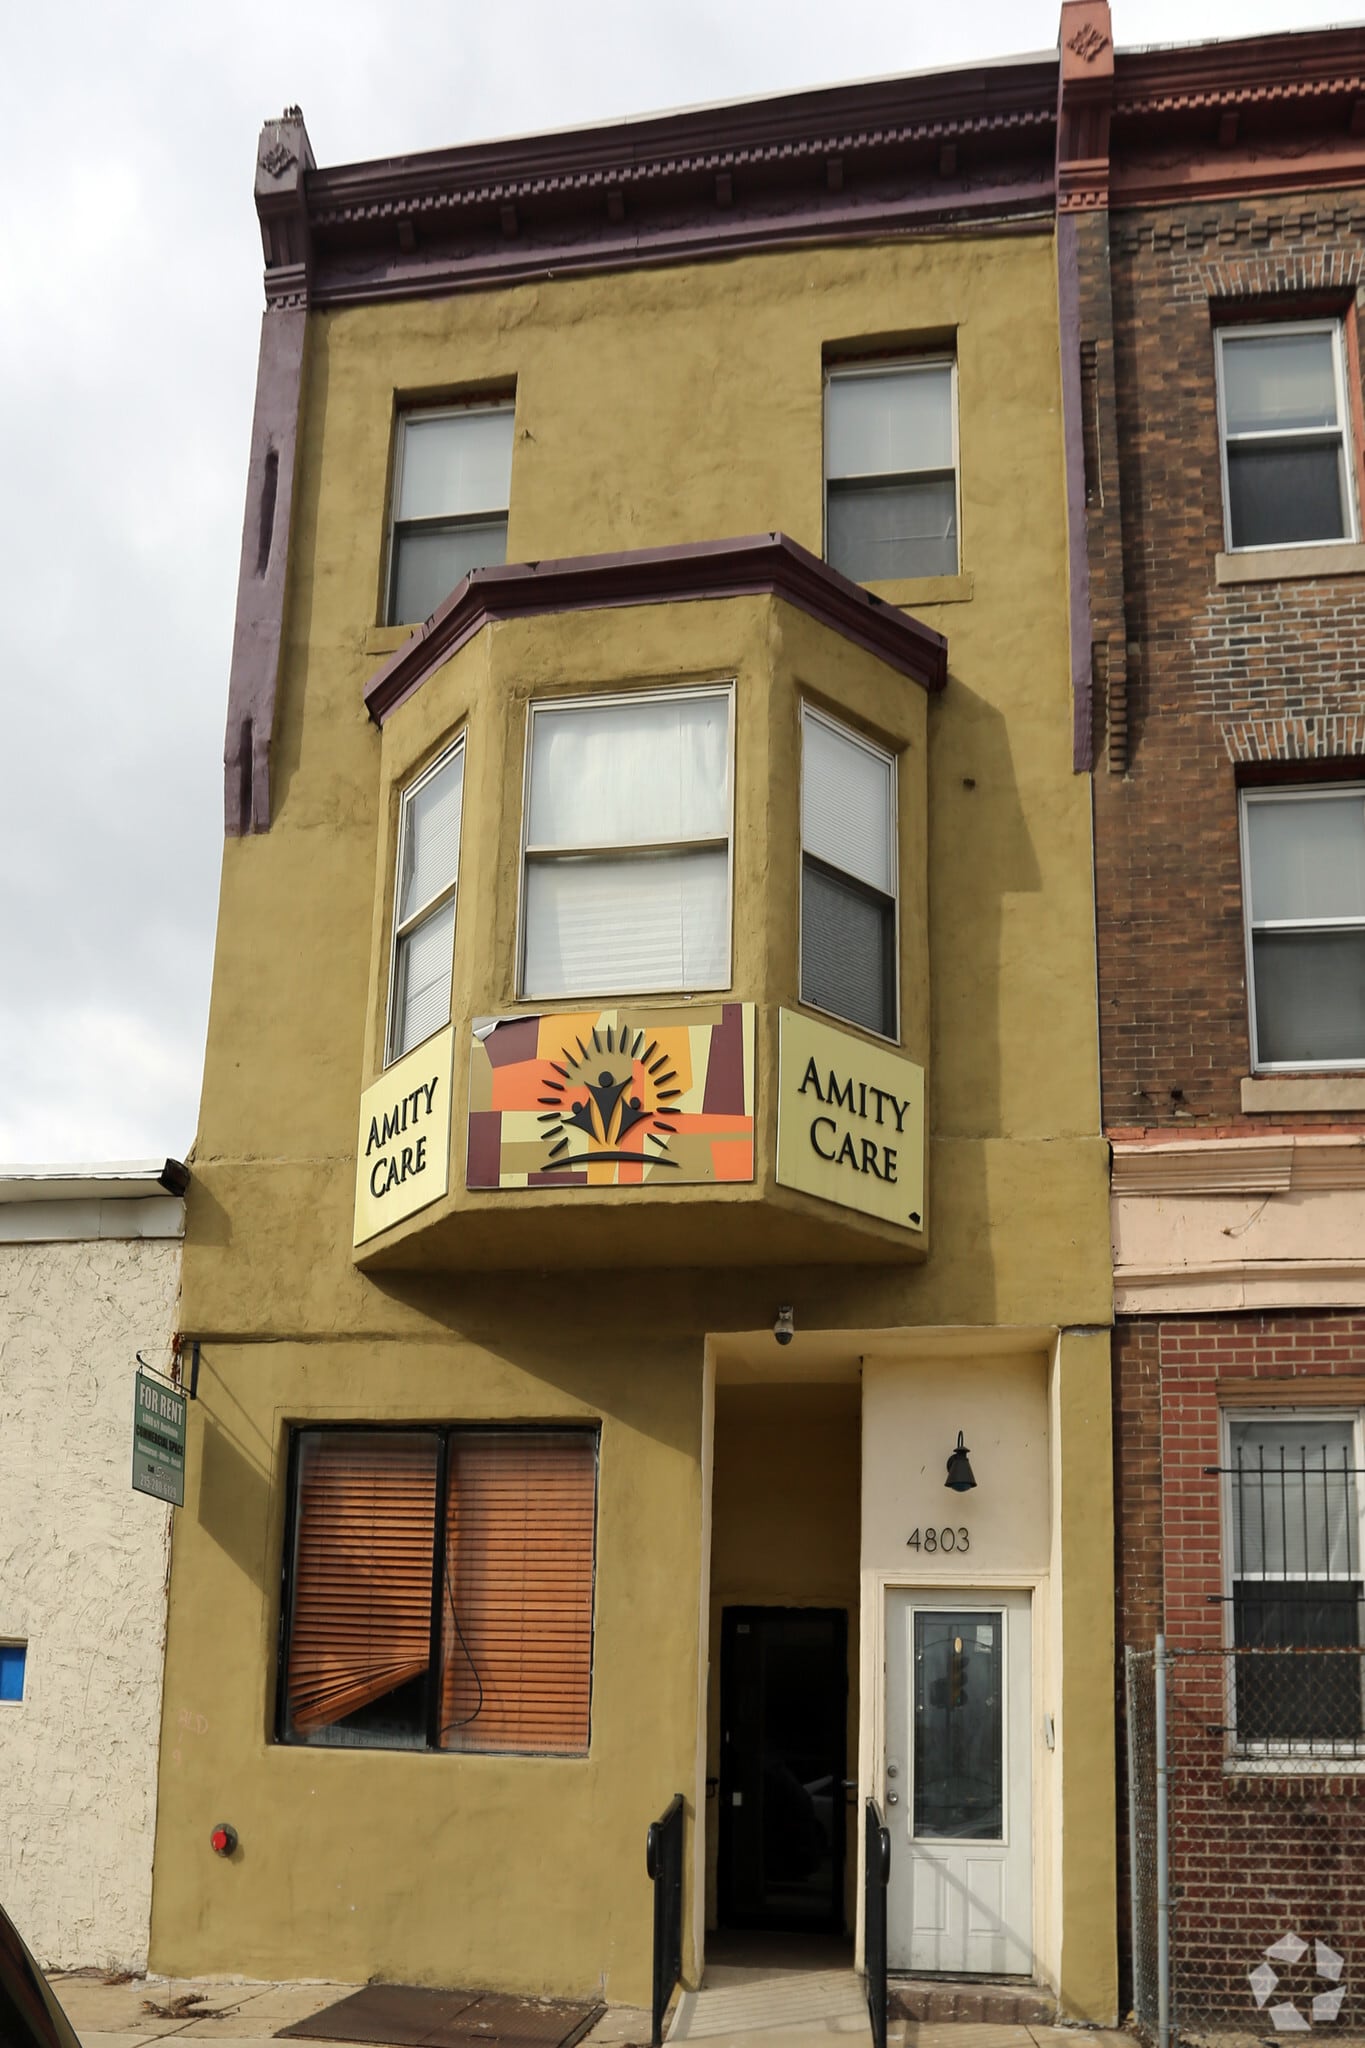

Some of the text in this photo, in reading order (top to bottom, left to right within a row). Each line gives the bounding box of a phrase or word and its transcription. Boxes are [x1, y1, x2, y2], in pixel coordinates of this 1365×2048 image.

[365, 1076, 439, 1157] AMITY
[797, 1055, 911, 1133] AMITY
[369, 1136, 427, 1199] CARE
[810, 1116, 898, 1184] CARE
[140, 1382, 158, 1413] FOR
[160, 1393, 184, 1426] RENT
[906, 1527, 970, 1553] 4803
